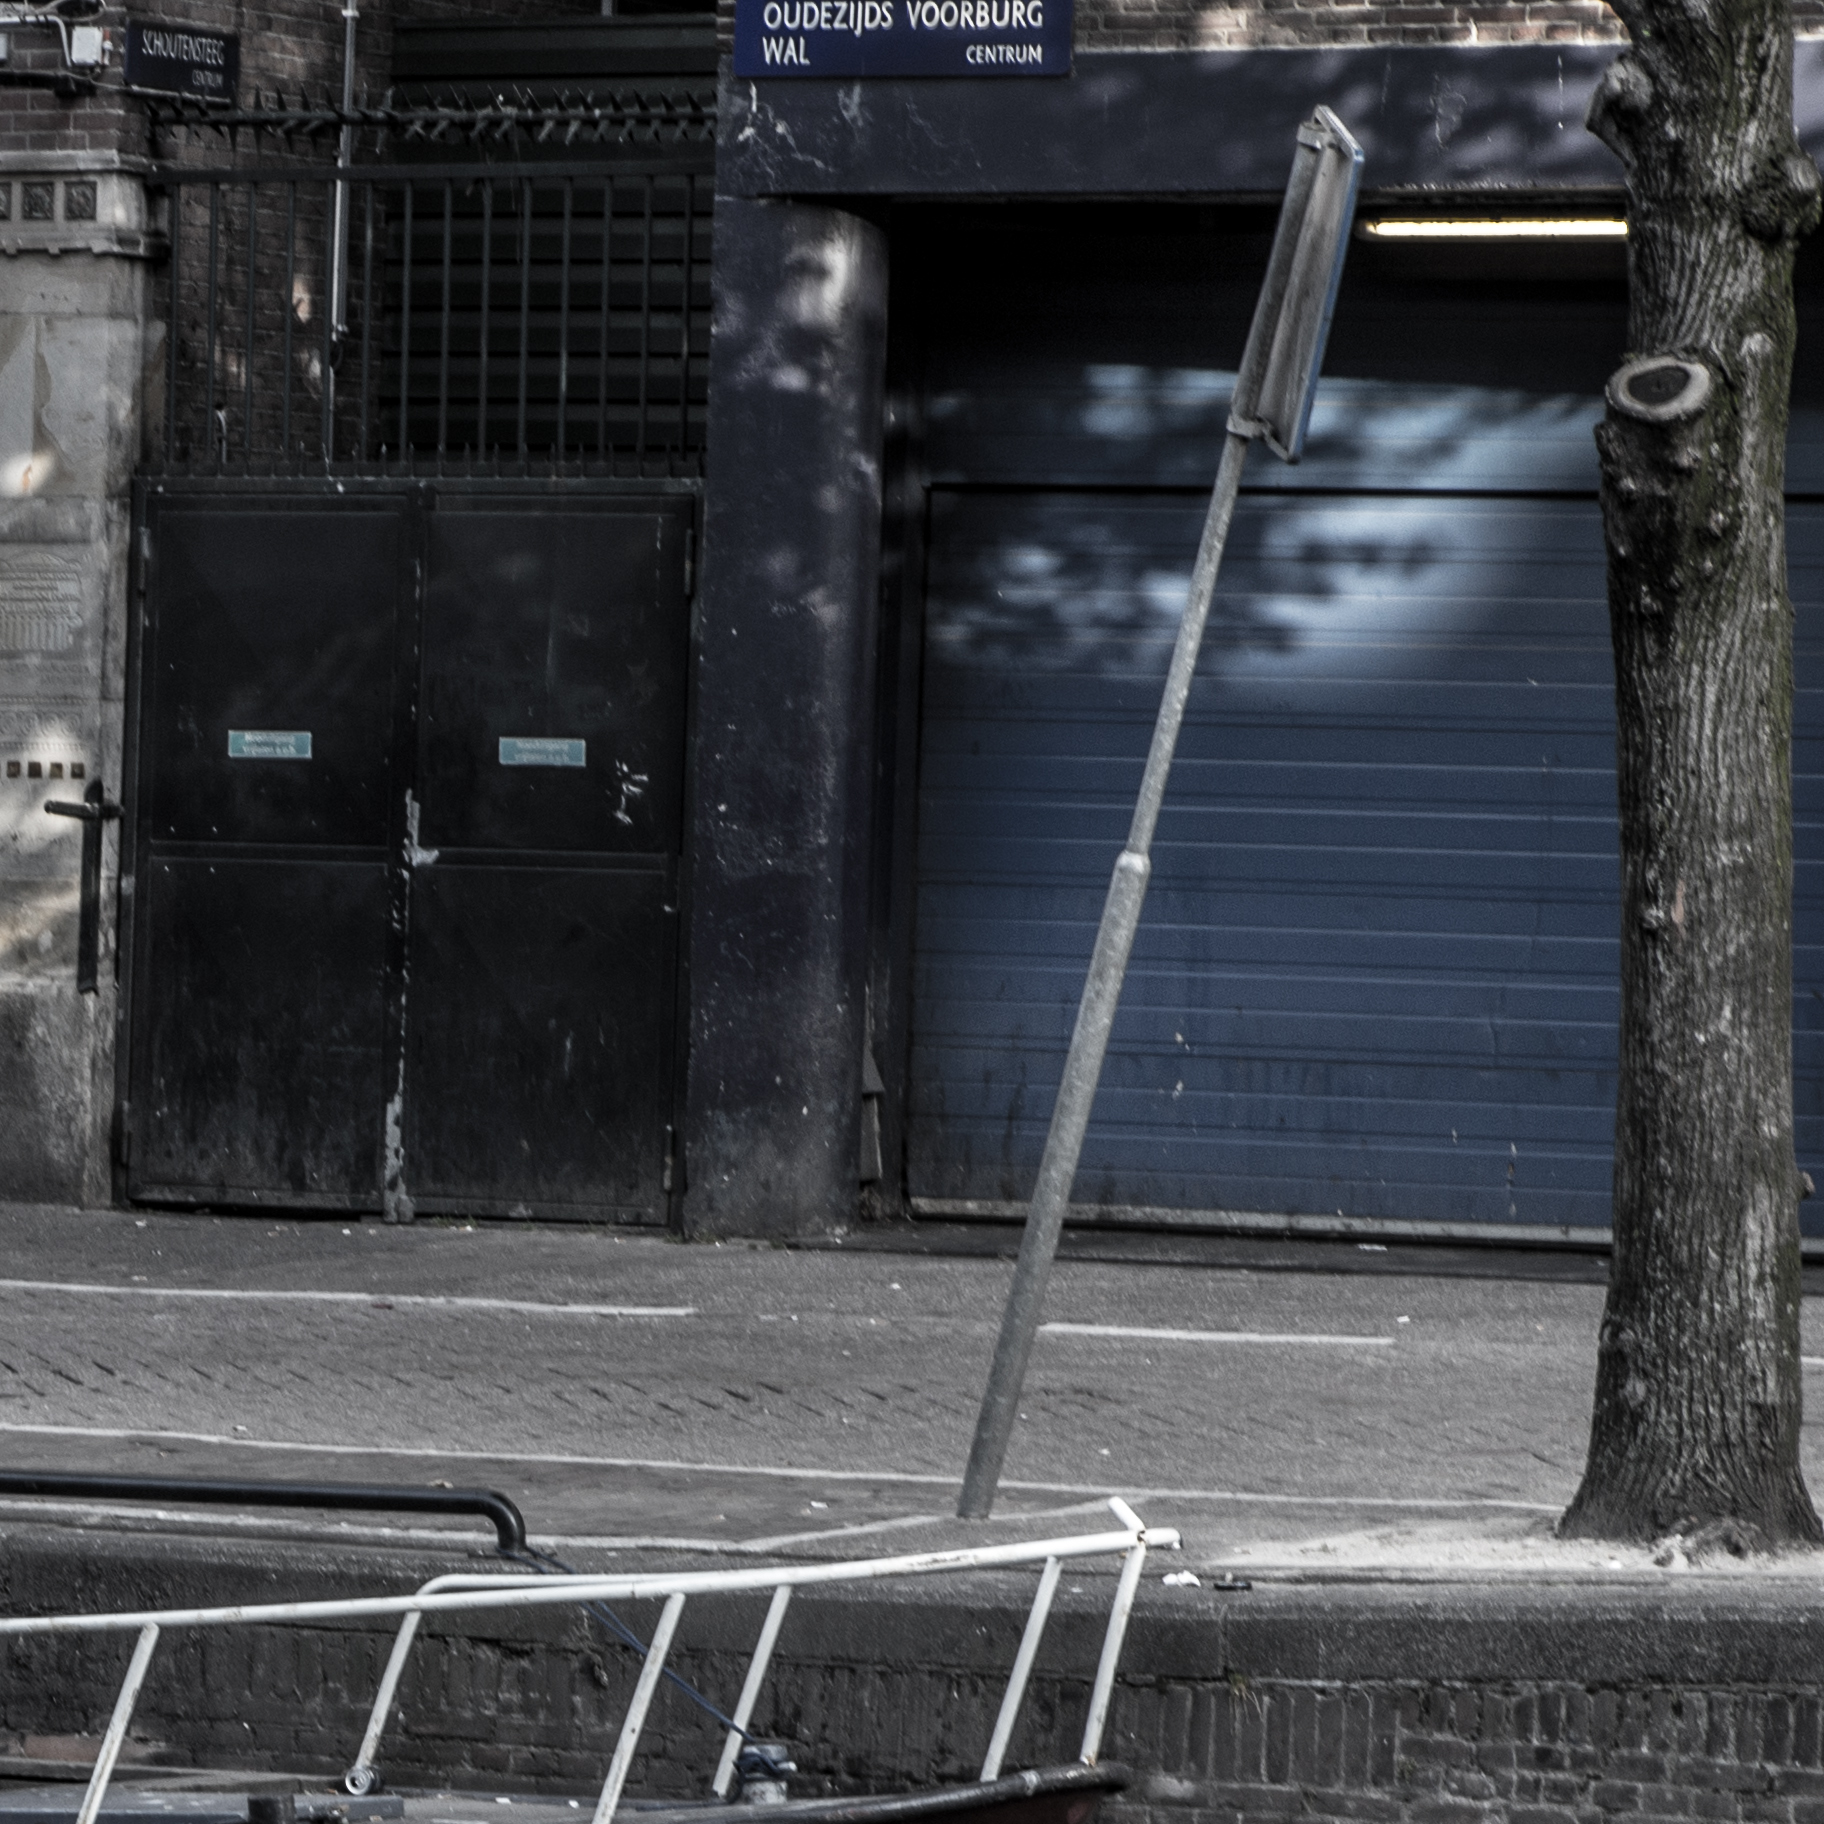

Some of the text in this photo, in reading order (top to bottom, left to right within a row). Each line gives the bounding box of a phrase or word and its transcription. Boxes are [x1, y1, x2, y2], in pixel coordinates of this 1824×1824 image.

[763, 0, 1044, 37] OUDEZIJDS VOORBURG
[142, 29, 226, 67] SCHOUTENSTEEG
[762, 36, 810, 66] WAL
[966, 44, 1043, 65] CENTRUM
[192, 69, 223, 87] CENTRUM
